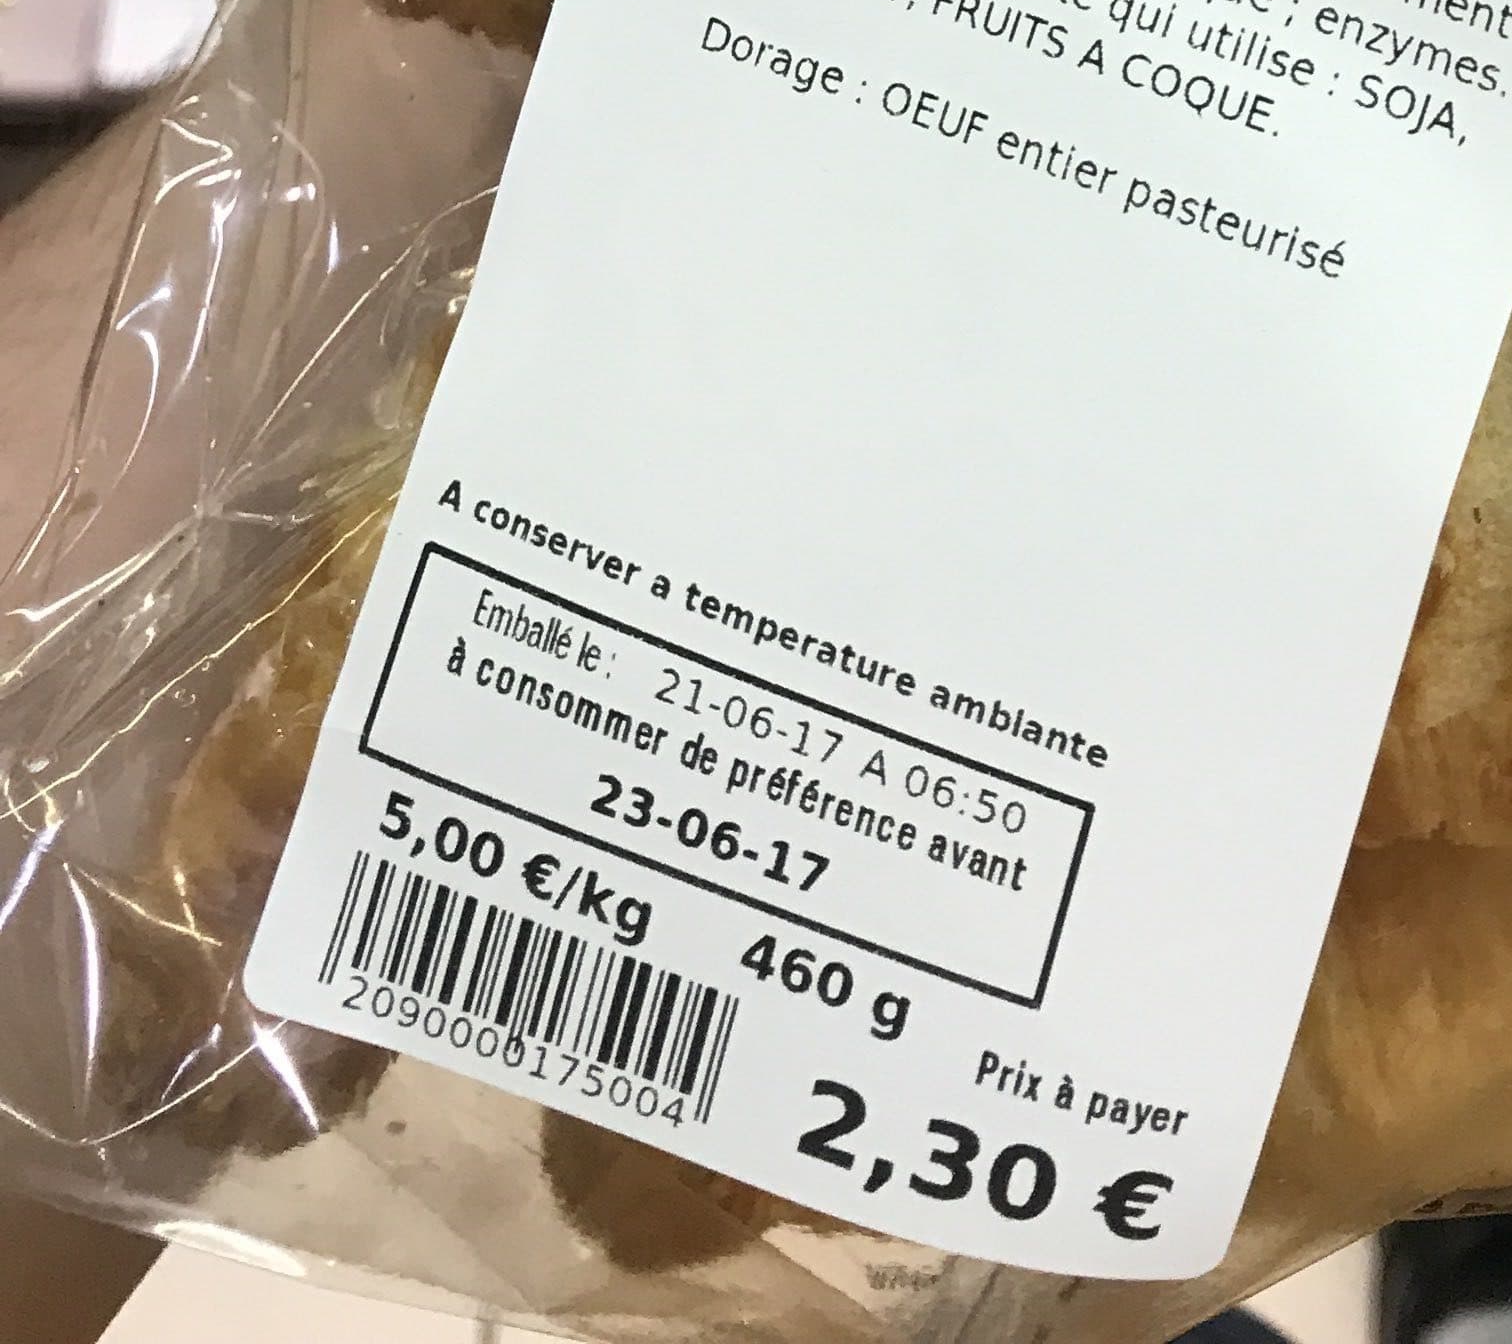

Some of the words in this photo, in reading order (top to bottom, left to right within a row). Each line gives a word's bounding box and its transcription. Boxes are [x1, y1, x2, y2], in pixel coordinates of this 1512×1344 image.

[1076, 38, 1104, 76] A
[1121, 53, 1279, 137] COQUE.
[1186, 20, 1316, 87] utilise
[1327, 72, 1340, 97] :
[1354, 74, 1467, 147] SOJA,
[1314, 6, 1506, 98] enzymes.
[700, 16, 845, 95] Dorage
[855, 80, 868, 105] :
[881, 82, 990, 145] OEUF
[996, 130, 1119, 194] entier
[1122, 177, 1347, 279] pasteurisé
[437, 479, 462, 513] A
[473, 499, 643, 586] conserver
[649, 574, 672, 601] a
[685, 582, 917, 697] temperature
[929, 684, 1109, 769] ambiante
[446, 635, 467, 678] à
[475, 657, 669, 756] consommer
[679, 731, 719, 776] de
[724, 757, 917, 851] préférence
[927, 834, 1028, 892] avant
[471, 587, 574, 660] Emballé
[575, 630, 602, 673] le
[605, 652, 617, 680] :
[653, 667, 844, 763] 21-06-17
[858, 749, 887, 787] A
[904, 764, 1027, 834] 06:50
[378, 789, 506, 879] 5,00
[520, 853, 653, 948] €/kg
[589, 773, 831, 892] 23-06-17
[342, 975, 684, 1128] 2090000175004
[739, 933, 854, 1008] 460
[869, 991, 912, 1042] g
[796, 1078, 1058, 1222] 2,30
[1091, 1169, 1175, 1241] €
[974, 1049, 1043, 1103] Prix
[1053, 1073, 1075, 1111] à
[1084, 1090, 1189, 1136] payer
